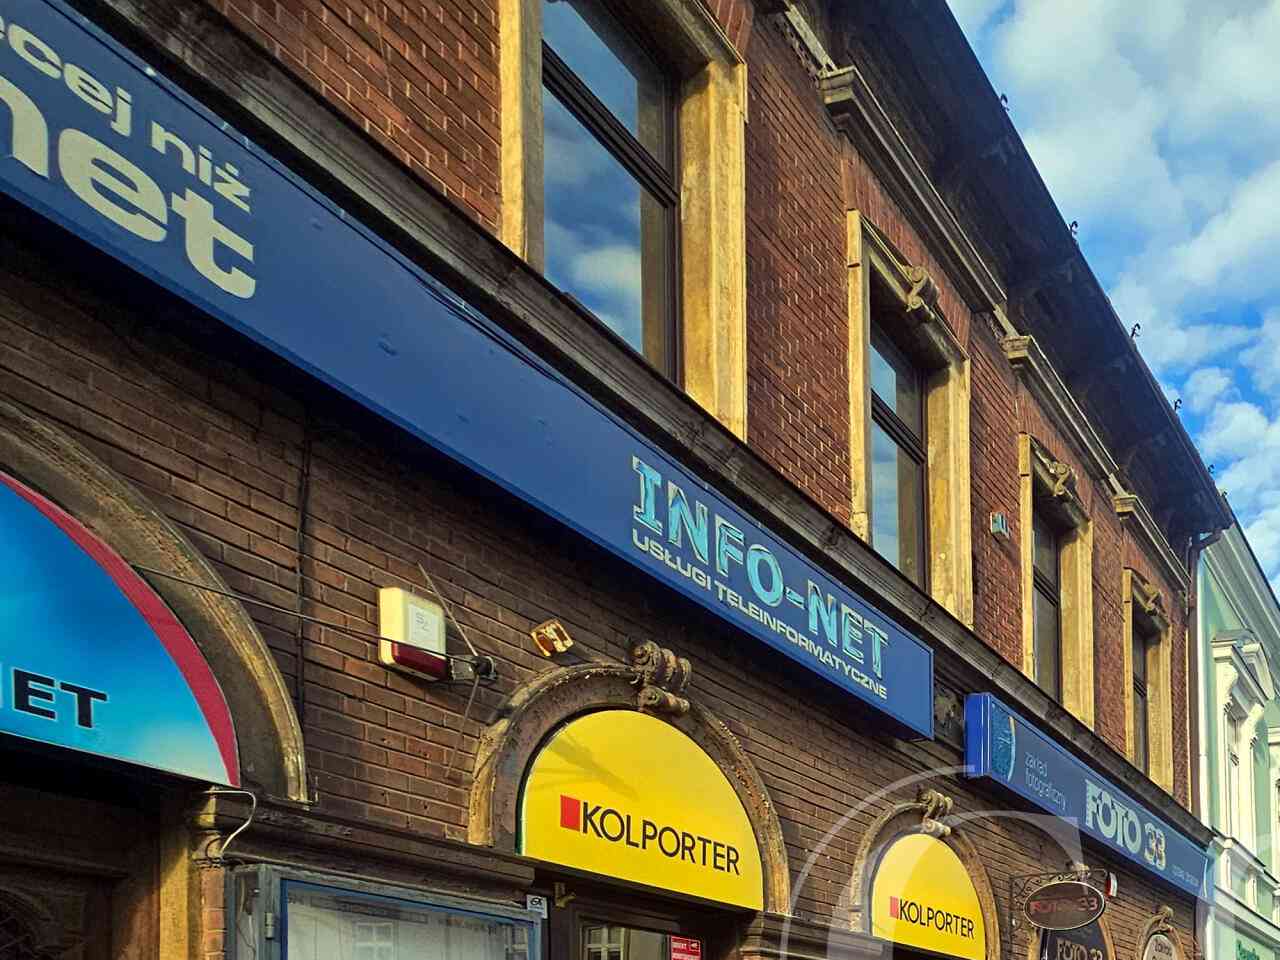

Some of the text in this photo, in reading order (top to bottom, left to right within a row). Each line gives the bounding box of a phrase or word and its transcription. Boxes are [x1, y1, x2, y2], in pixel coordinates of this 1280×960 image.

[0, 14, 252, 216] cej niż
[632, 454, 889, 680] INFO-NET
[632, 527, 888, 701] USŁUGI TELEINFORMATYCZNE
[1, 664, 108, 730] ET
[582, 801, 740, 876] KOLPORTER
[1085, 778, 1168, 872] FOTO 33
[899, 898, 975, 940] KOLPORTER
